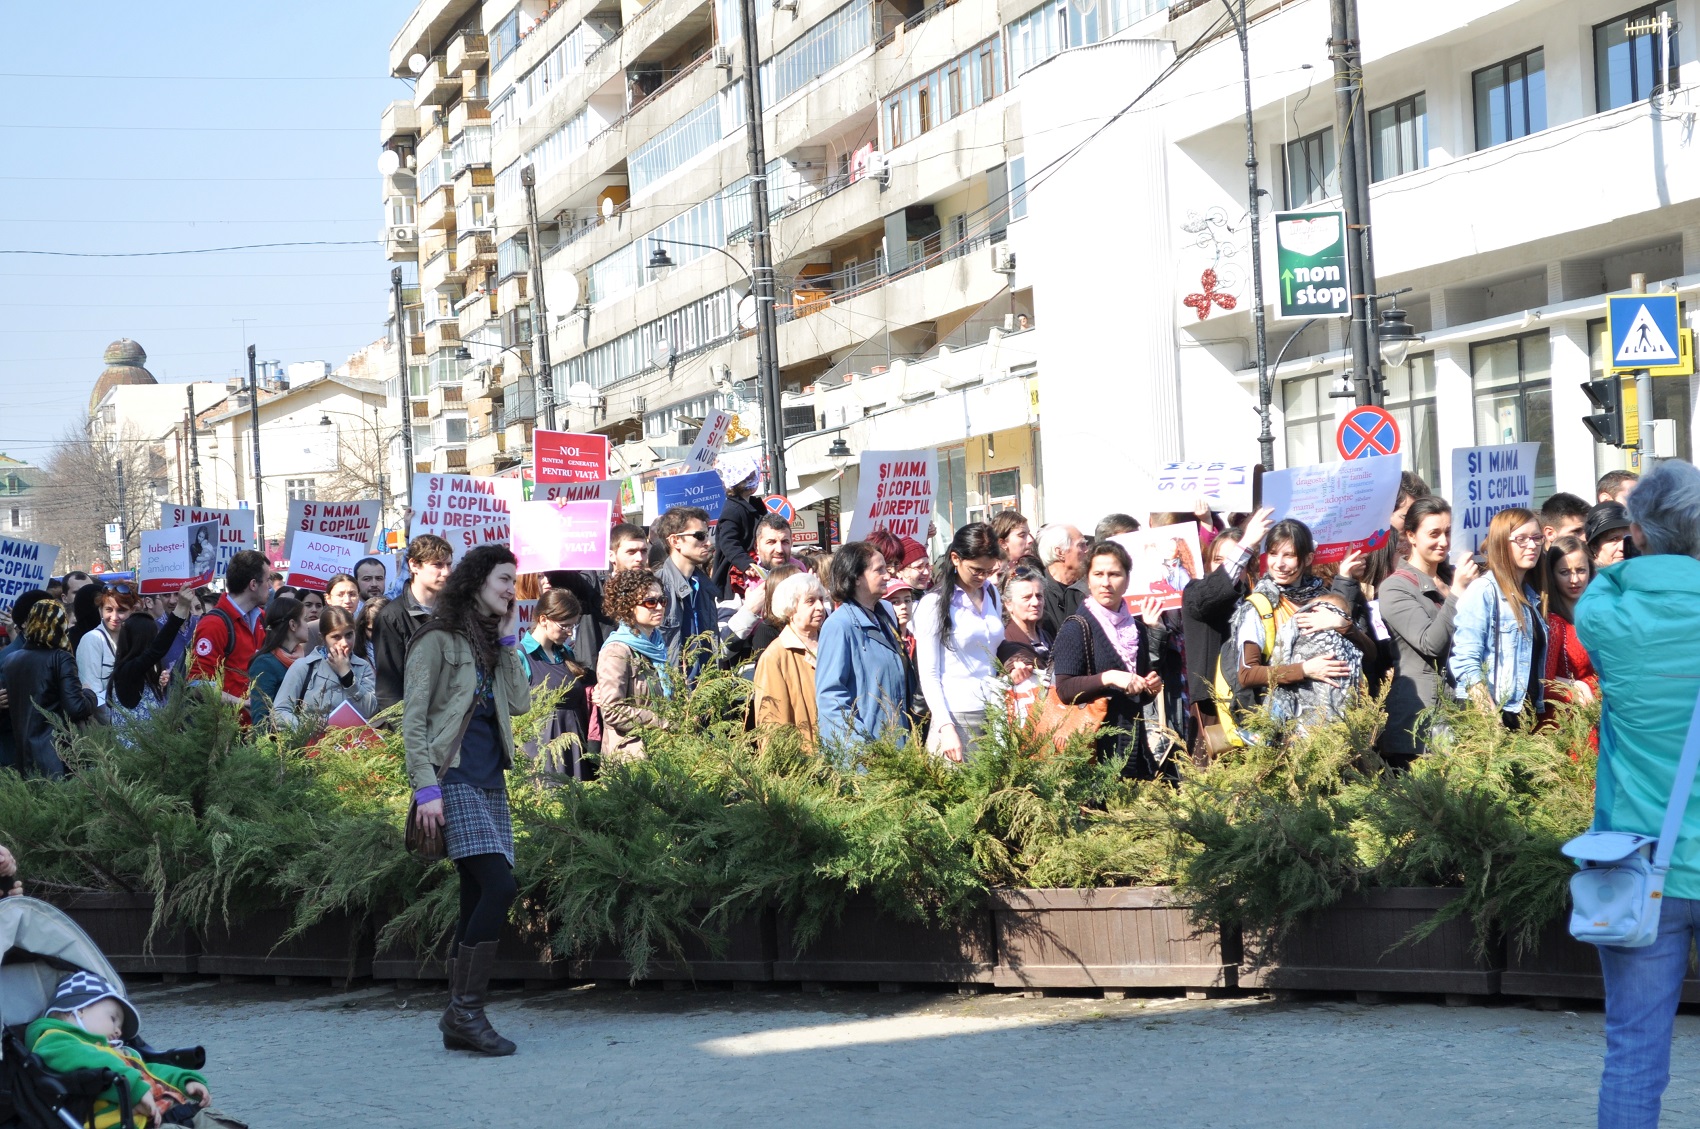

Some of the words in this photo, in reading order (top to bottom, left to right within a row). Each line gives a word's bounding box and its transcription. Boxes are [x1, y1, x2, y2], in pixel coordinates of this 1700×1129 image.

[1294, 265, 1340, 283] non
[1296, 284, 1346, 308] stop
[559, 446, 580, 457] NOI
[695, 447, 709, 462] AU
[541, 457, 564, 465] SUNTEM
[567, 460, 599, 468] GENERAȚIA
[893, 461, 926, 478] MAMA
[1488, 449, 1519, 473] MAMA
[542, 467, 573, 477] PENTRU
[574, 470, 599, 480] VIAȚĂ
[1295, 477, 1326, 487] dragoste
[1349, 471, 1373, 481] familie
[428, 476, 444, 493] ȘI
[450, 478, 495, 496] MAMA
[565, 484, 600, 501] MAMA
[683, 485, 705, 498] NOI
[888, 479, 931, 497] COPILUL
[1487, 475, 1530, 500] COPILUL
[323, 504, 360, 517] MAMA
[427, 493, 442, 511] ȘI
[447, 494, 511, 515] COPILUL
[665, 500, 688, 509] SUNTEM
[869, 501, 882, 519] AU
[882, 498, 930, 517] DREPTUL
[319, 517, 371, 533] COPILUL
[420, 510, 439, 526] AU
[888, 516, 919, 537] VIAȚĂ
[1463, 506, 1481, 530] AU
[1, 540, 39, 561] MAMA
[307, 541, 351, 558] ADOPȚIA
[147, 556, 160, 566] pe
